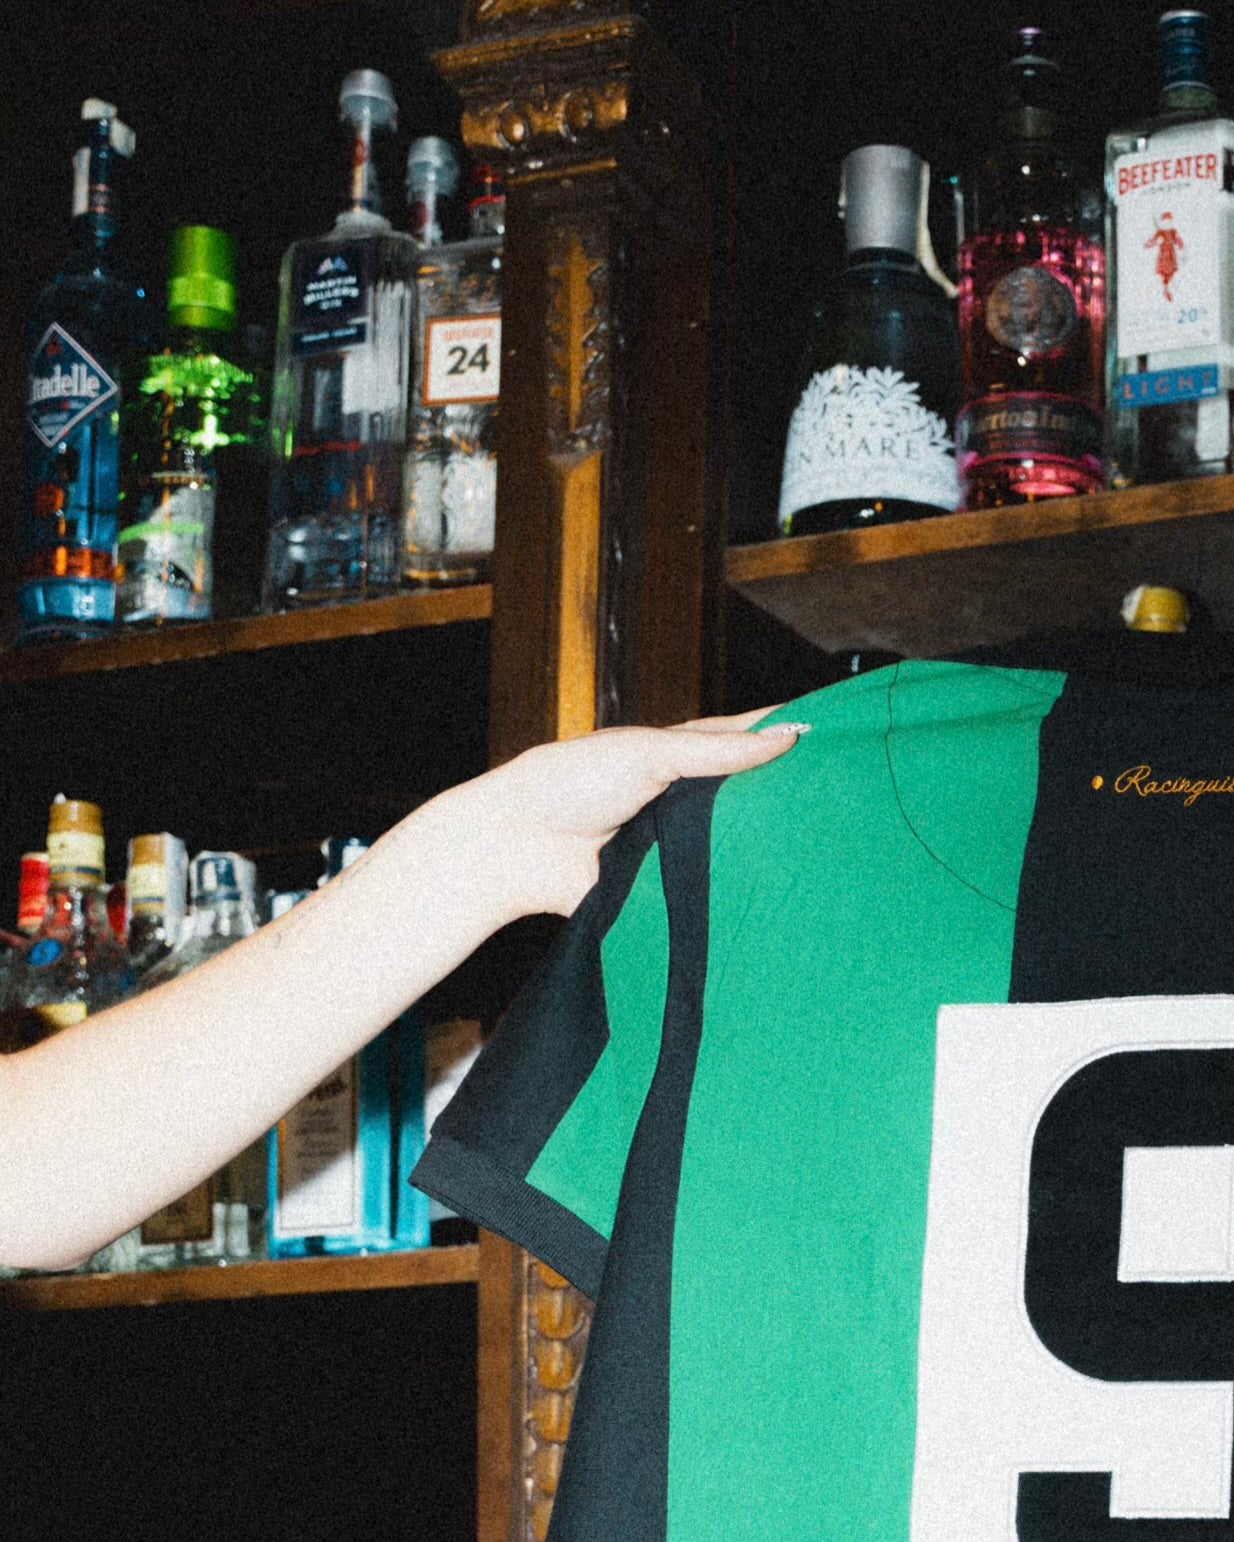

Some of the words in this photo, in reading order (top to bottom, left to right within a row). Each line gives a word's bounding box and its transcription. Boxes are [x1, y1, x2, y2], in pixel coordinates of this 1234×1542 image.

[1118, 153, 1217, 197] BEEFEATER
[447, 343, 490, 375] 24
[1123, 370, 1212, 400] LIGHT
[824, 437, 918, 460] MARE
